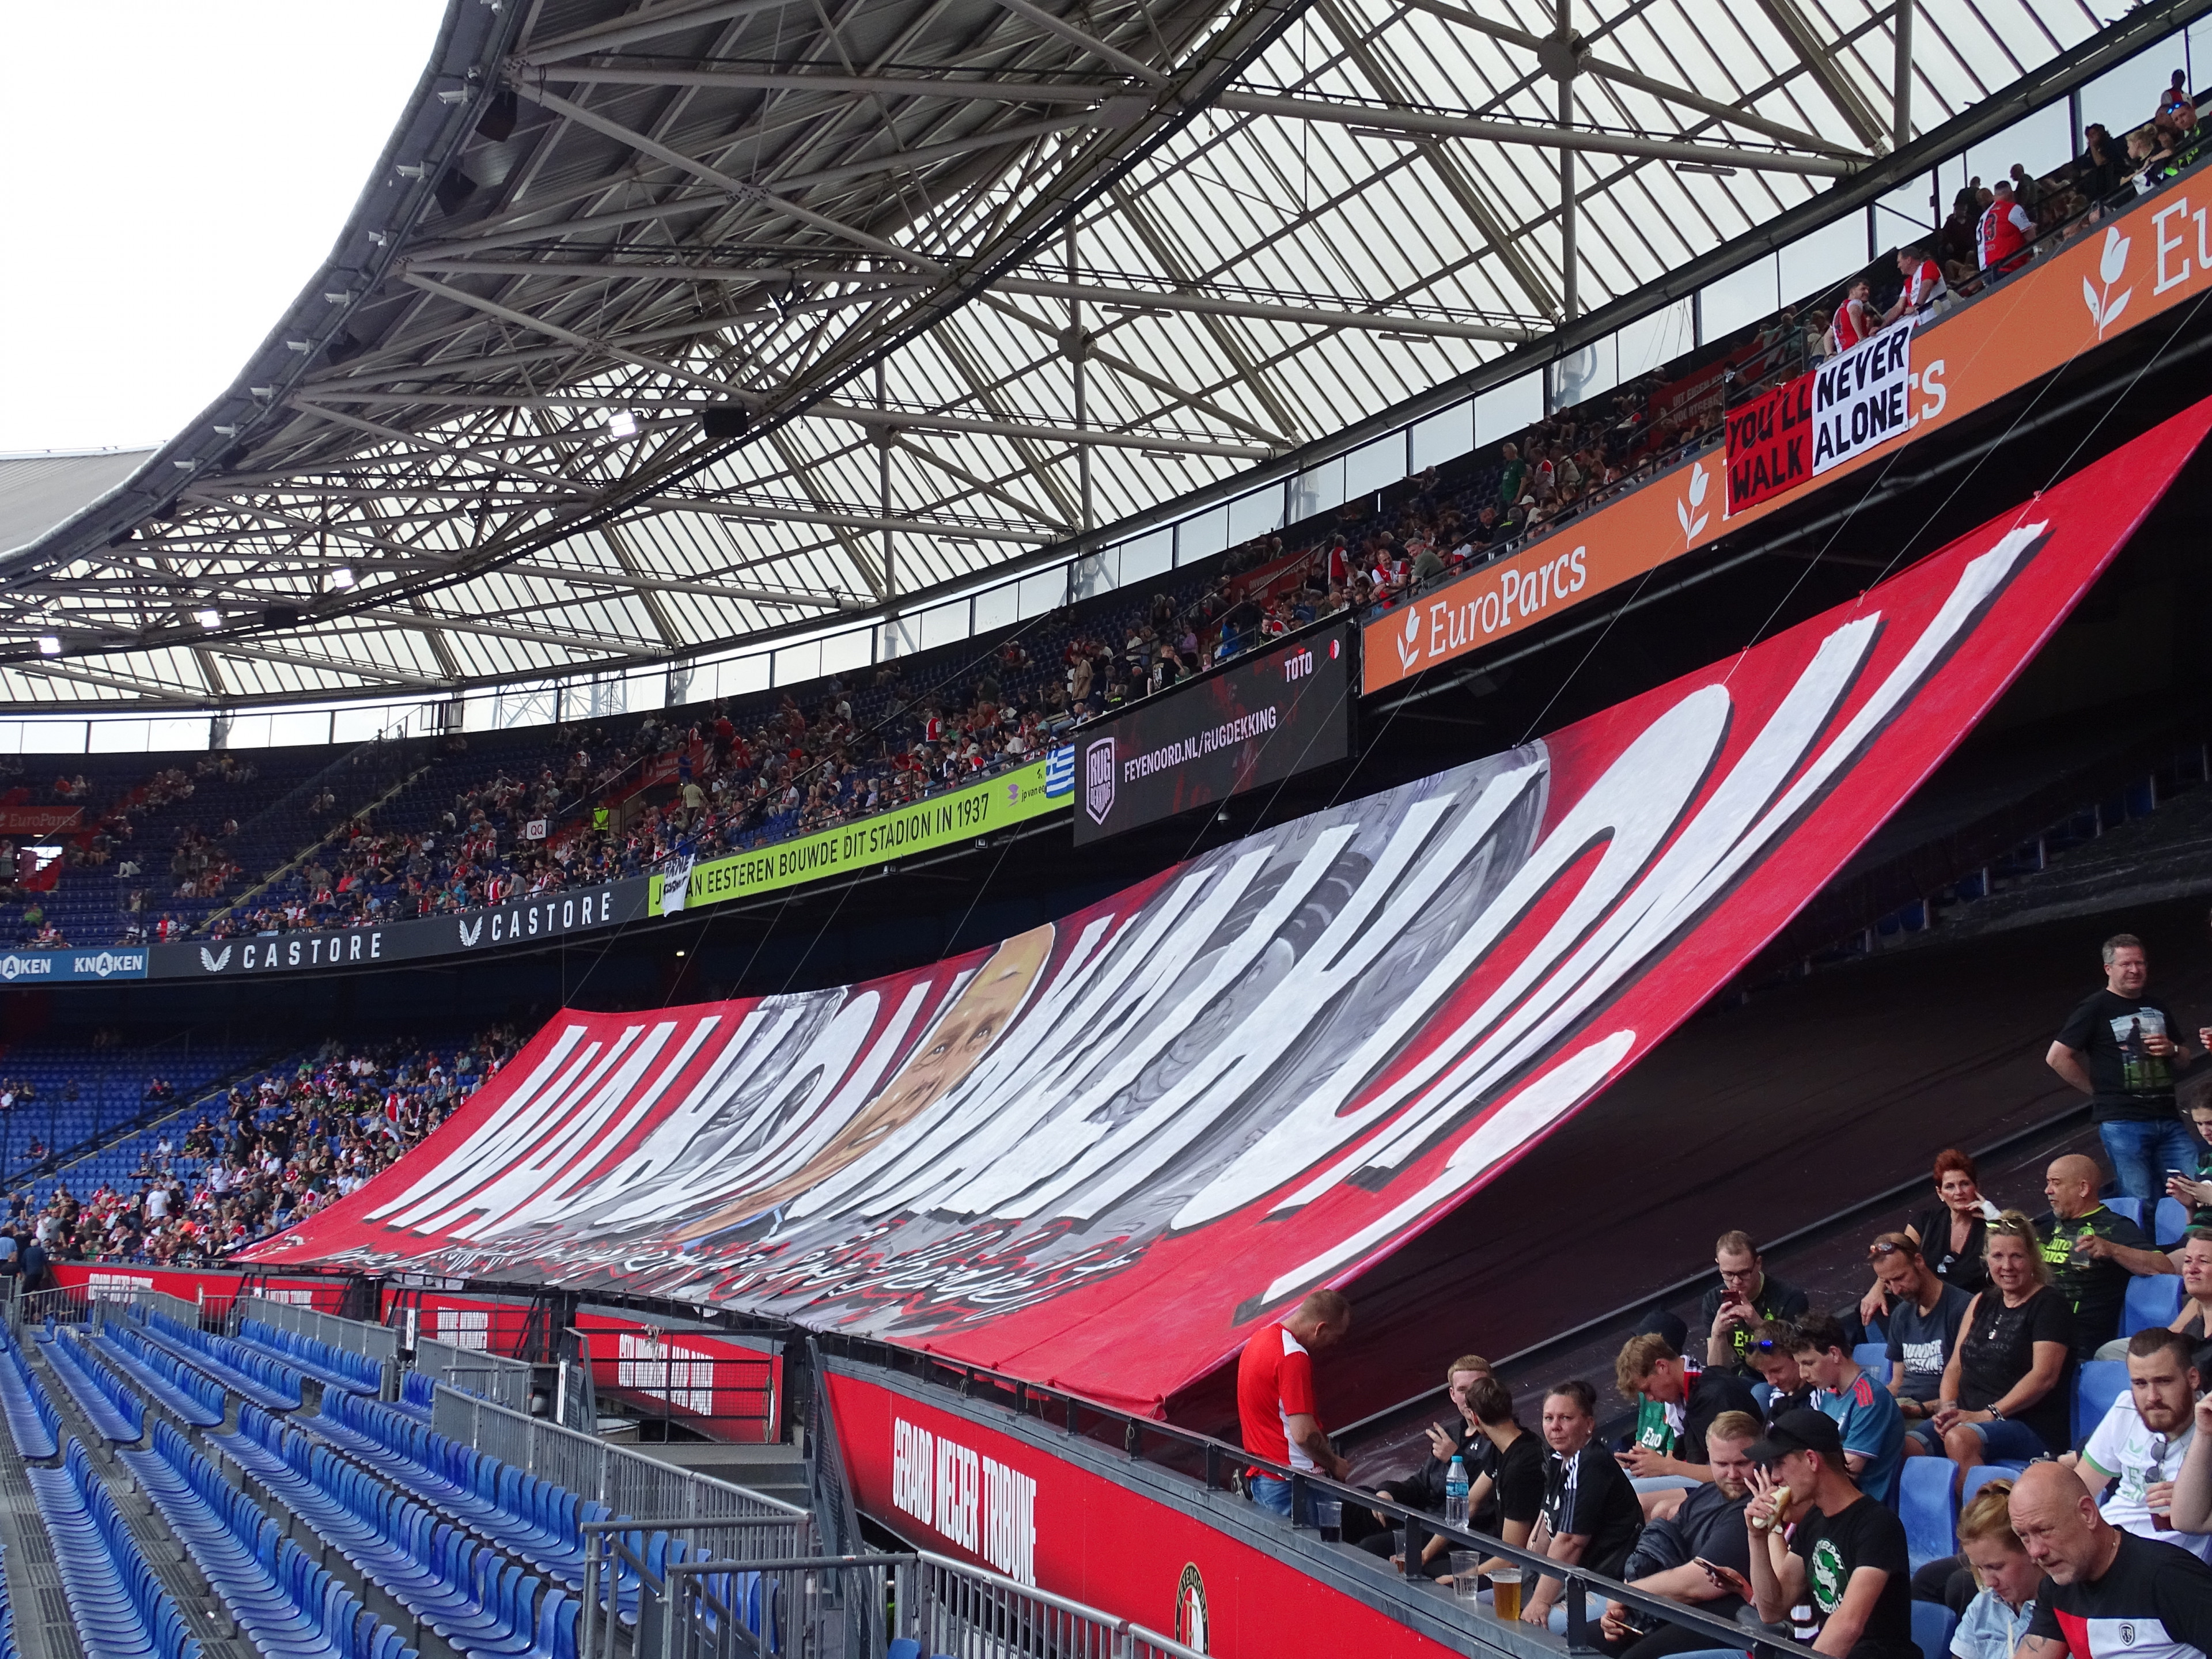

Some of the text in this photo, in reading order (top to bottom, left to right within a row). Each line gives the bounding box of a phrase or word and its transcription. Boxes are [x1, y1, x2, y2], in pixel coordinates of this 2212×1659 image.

[1728, 384, 1812, 458] YOU'LL
[1817, 327, 1909, 413] NEVER
[1733, 435, 1804, 503] WALK
[1814, 382, 1904, 467] ALONE
[1429, 546, 1586, 658] EuroParcs
[1284, 651, 1312, 683] TOTO
[1090, 747, 1111, 787] RUG
[1124, 706, 1277, 783] FEYENOORD.NL/RUGDEKKING
[9, 813, 77, 827] EuroParcs
[707, 857, 774, 893] EESTEREN
[779, 839, 838, 876] BOUWDE
[843, 830, 866, 860] DIT
[870, 811, 931, 853] STADION
[936, 806, 952, 834] IN
[957, 793, 989, 828] 1937
[491, 892, 611, 941] CASTORE
[0, 954, 143, 975] AKEN KNAKEN
[243, 933, 381, 969] CASTORE
[893, 1416, 1036, 1588] GERARD MEIJER TRIBUNE
[1177, 1568, 1207, 1623] FEYENOORD
